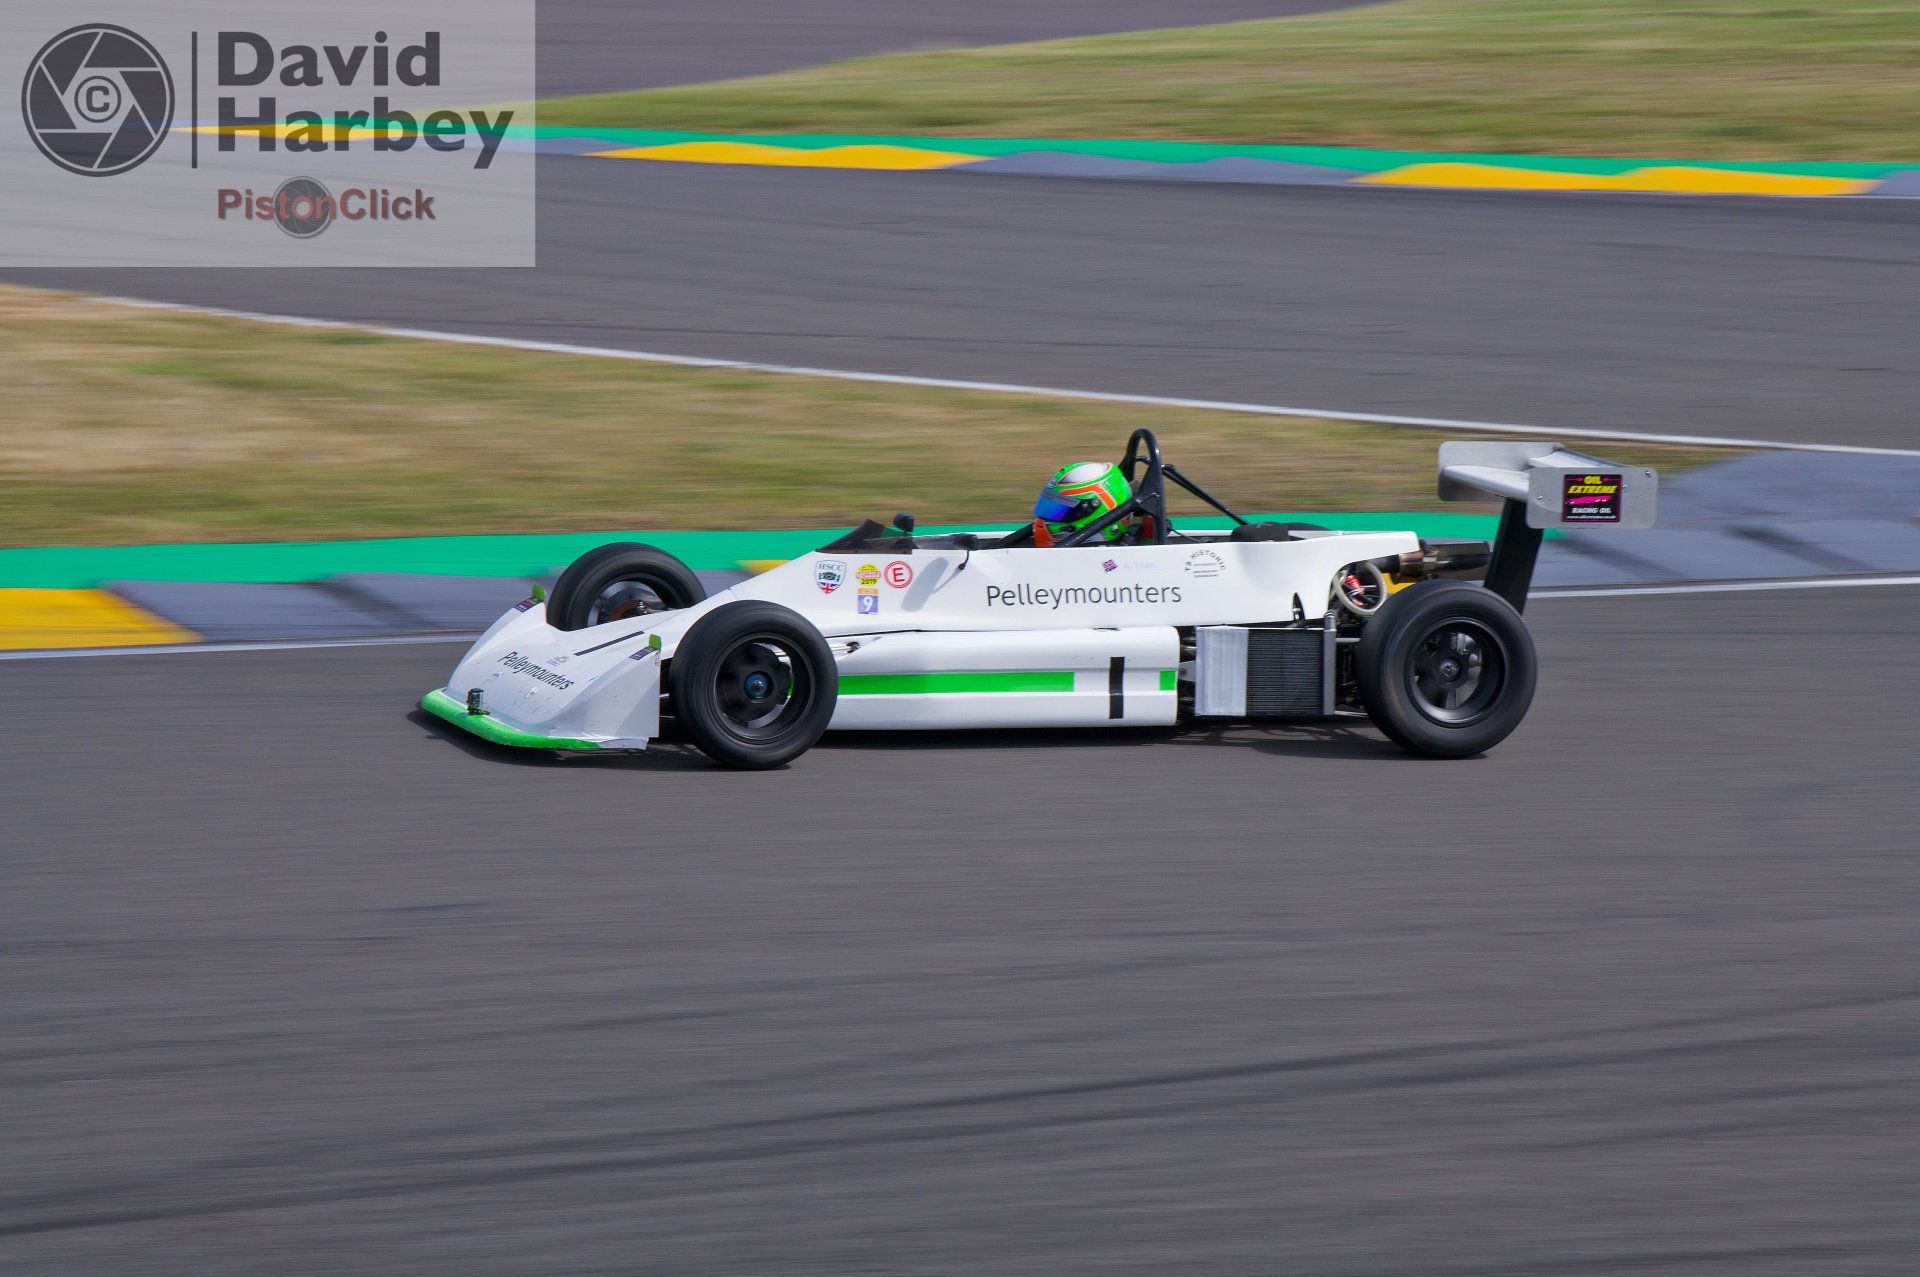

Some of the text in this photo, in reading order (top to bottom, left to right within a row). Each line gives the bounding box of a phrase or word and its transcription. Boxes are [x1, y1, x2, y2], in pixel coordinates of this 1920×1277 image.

[1584, 476, 1602, 484] OIL
[1568, 485, 1617, 494] EXTREME
[818, 563, 844, 572] HSCC
[892, 567, 905, 582] E
[986, 583, 1182, 610] Pelleymounters
[863, 596, 874, 613] 9
[497, 651, 575, 690] Pelleymounters
